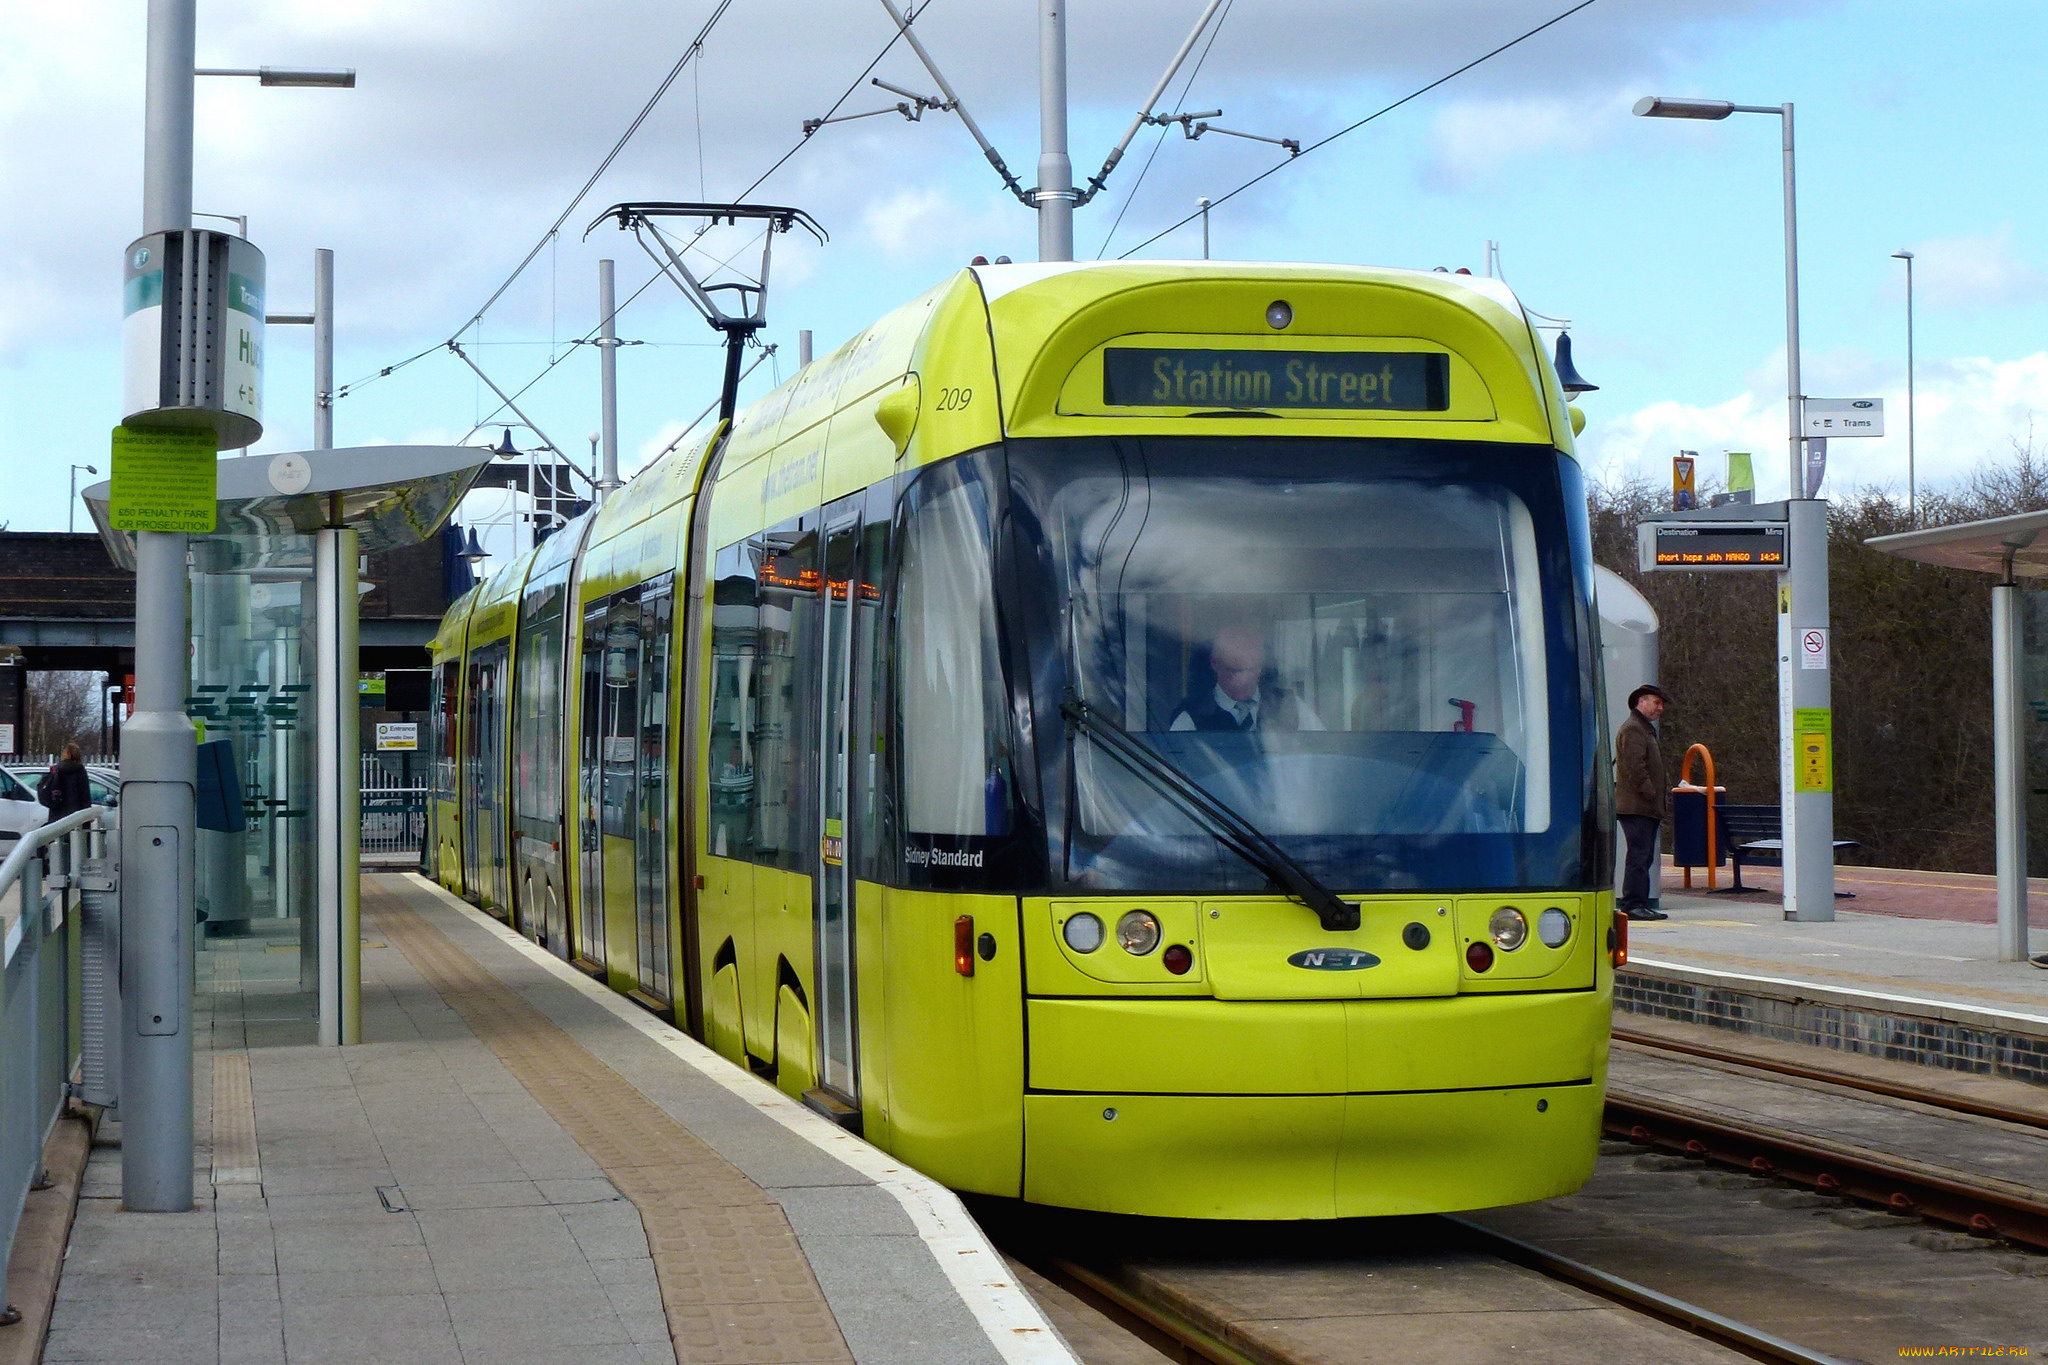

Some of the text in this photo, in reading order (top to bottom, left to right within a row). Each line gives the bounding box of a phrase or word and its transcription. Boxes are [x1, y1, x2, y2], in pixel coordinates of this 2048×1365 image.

[1153, 357, 1394, 404] Station Street
[936, 387, 973, 411] 209
[1843, 419, 1872, 427] Trams
[118, 508, 209, 519] £50 PENALTY FARE
[118, 520, 209, 531] OR PROSECUTION
[1657, 528, 1783, 536] Destination Mins
[1682, 553, 1703, 563] hops
[1706, 553, 1723, 561] with
[1725, 552, 1751, 561] MANGO
[1760, 553, 1780, 561] 14:34
[905, 846, 983, 868] Sidney Standard
[1303, 953, 1366, 966] NET
